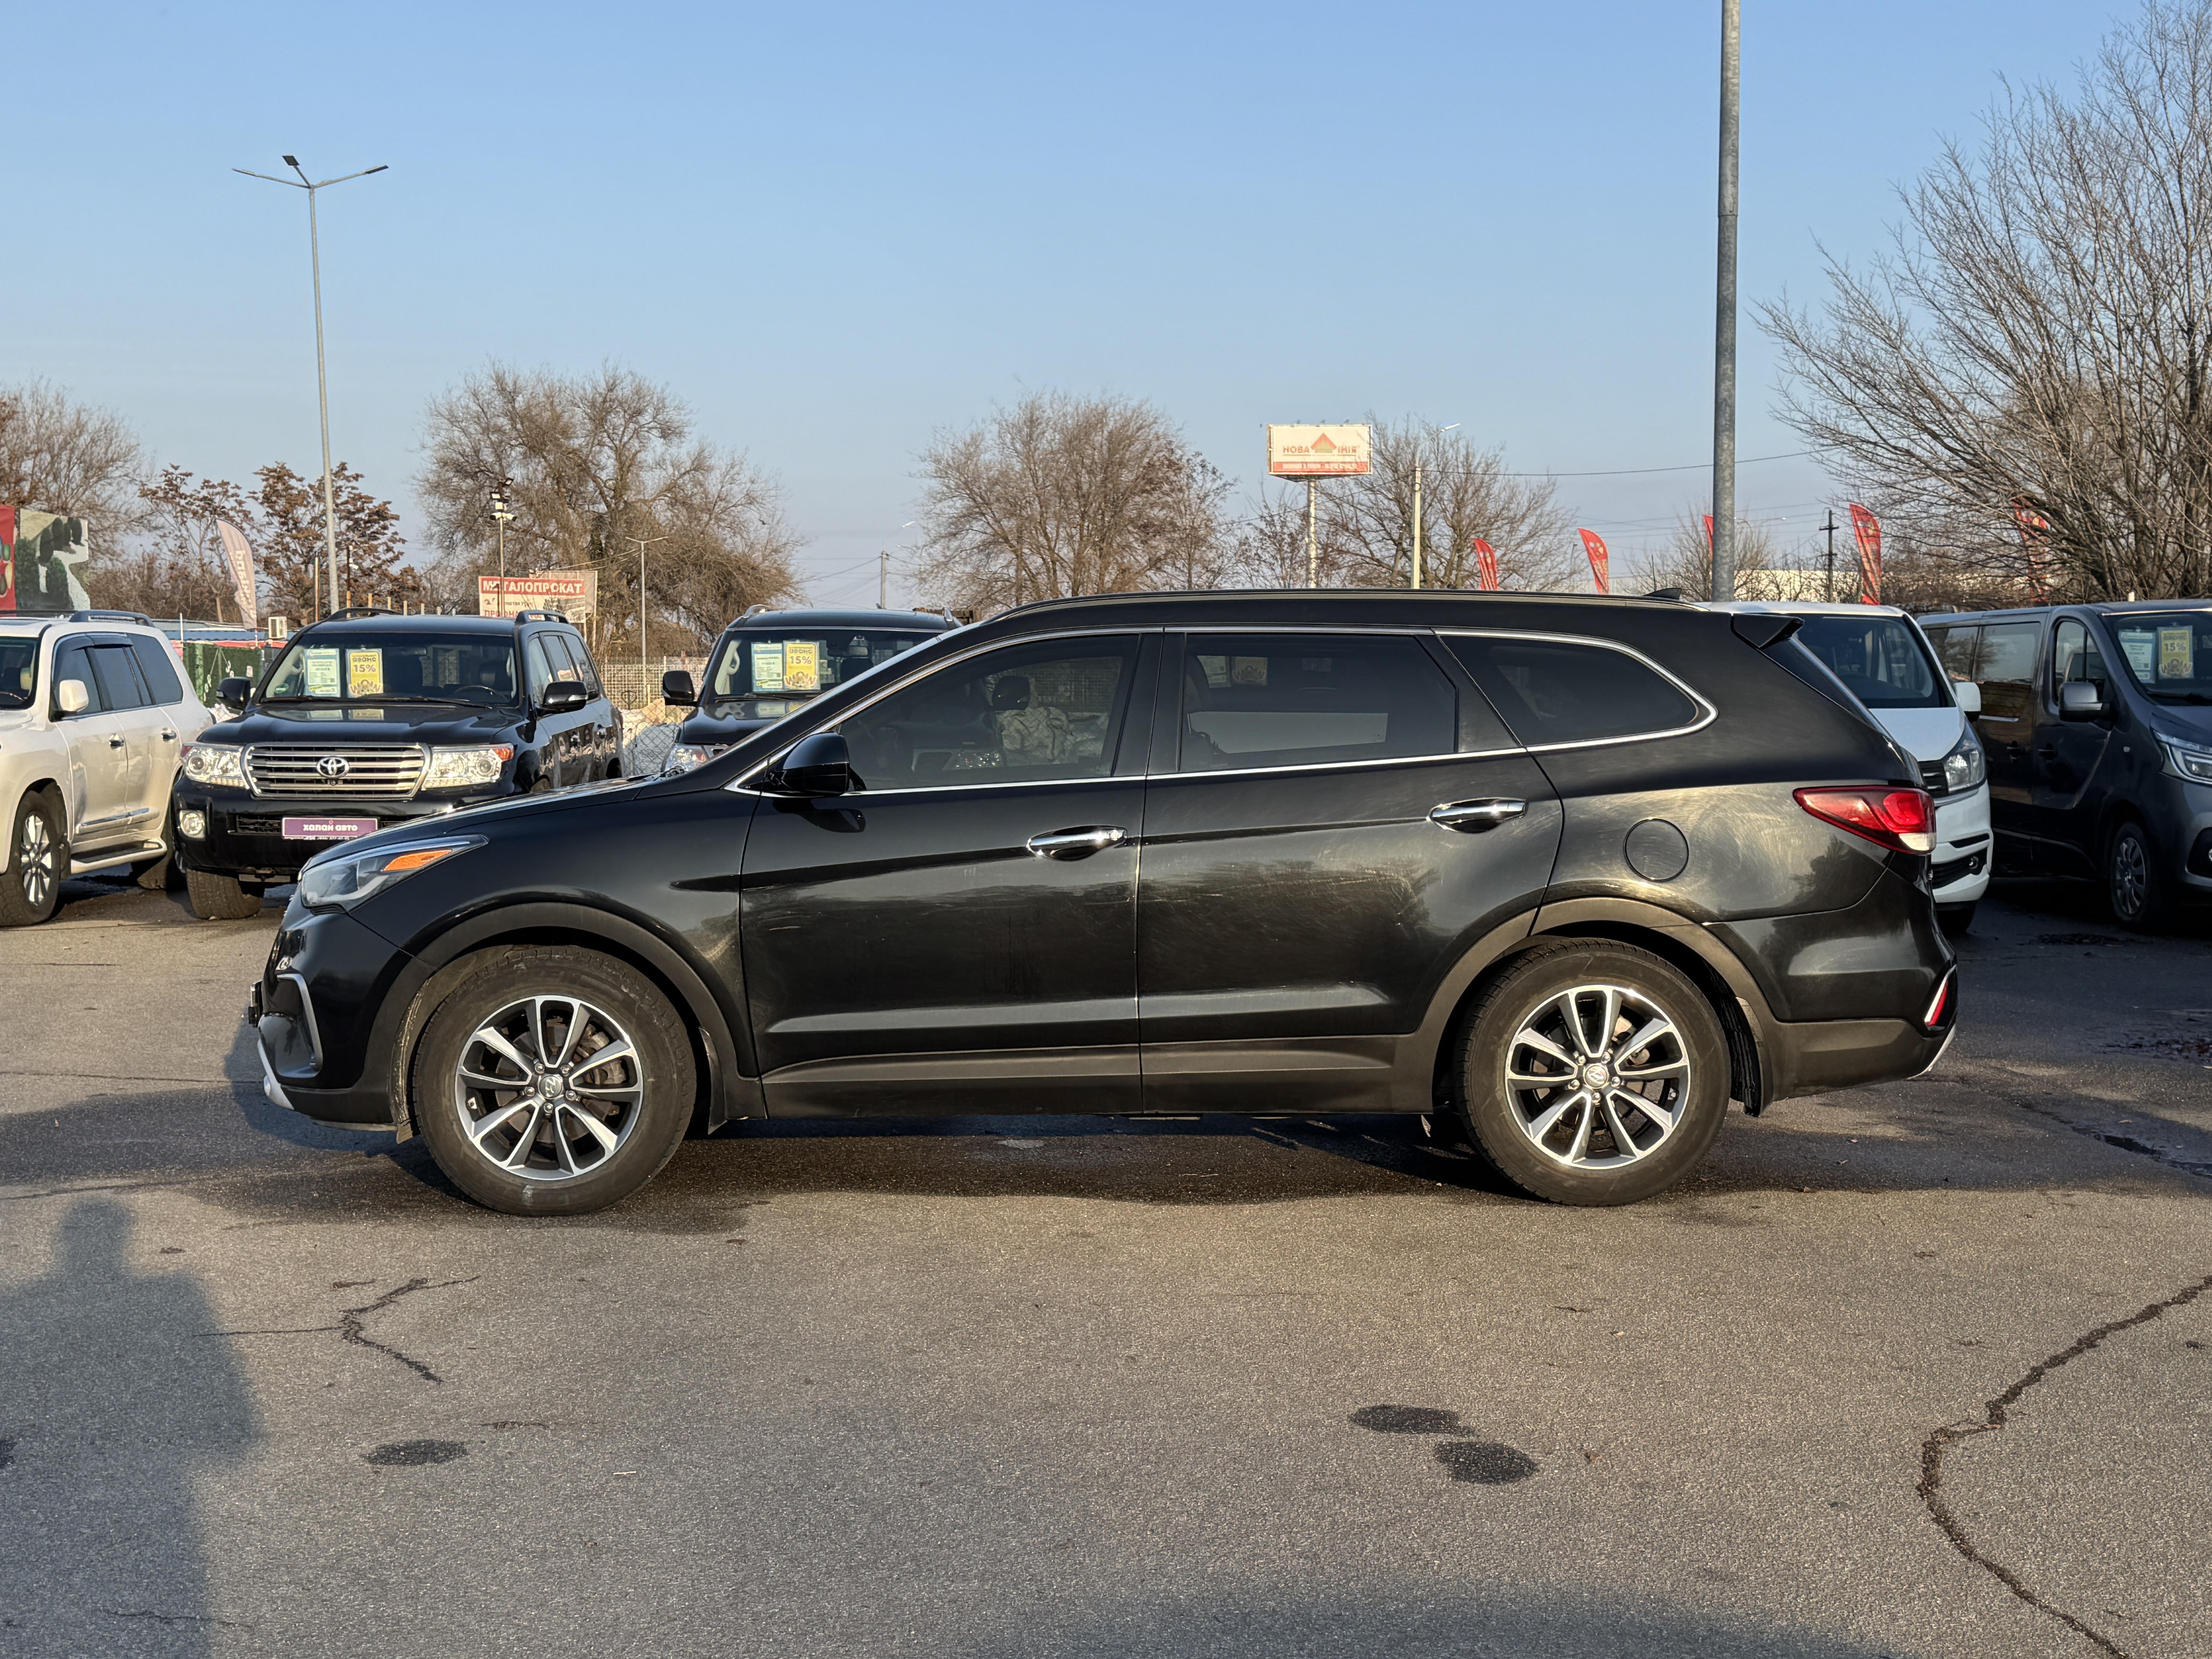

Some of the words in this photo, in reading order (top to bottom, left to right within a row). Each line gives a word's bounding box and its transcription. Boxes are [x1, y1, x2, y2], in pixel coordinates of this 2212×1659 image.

[2164, 643, 2186, 651] 15%
[790, 656, 812, 664] 15%
[303, 822, 334, 831] хапай
